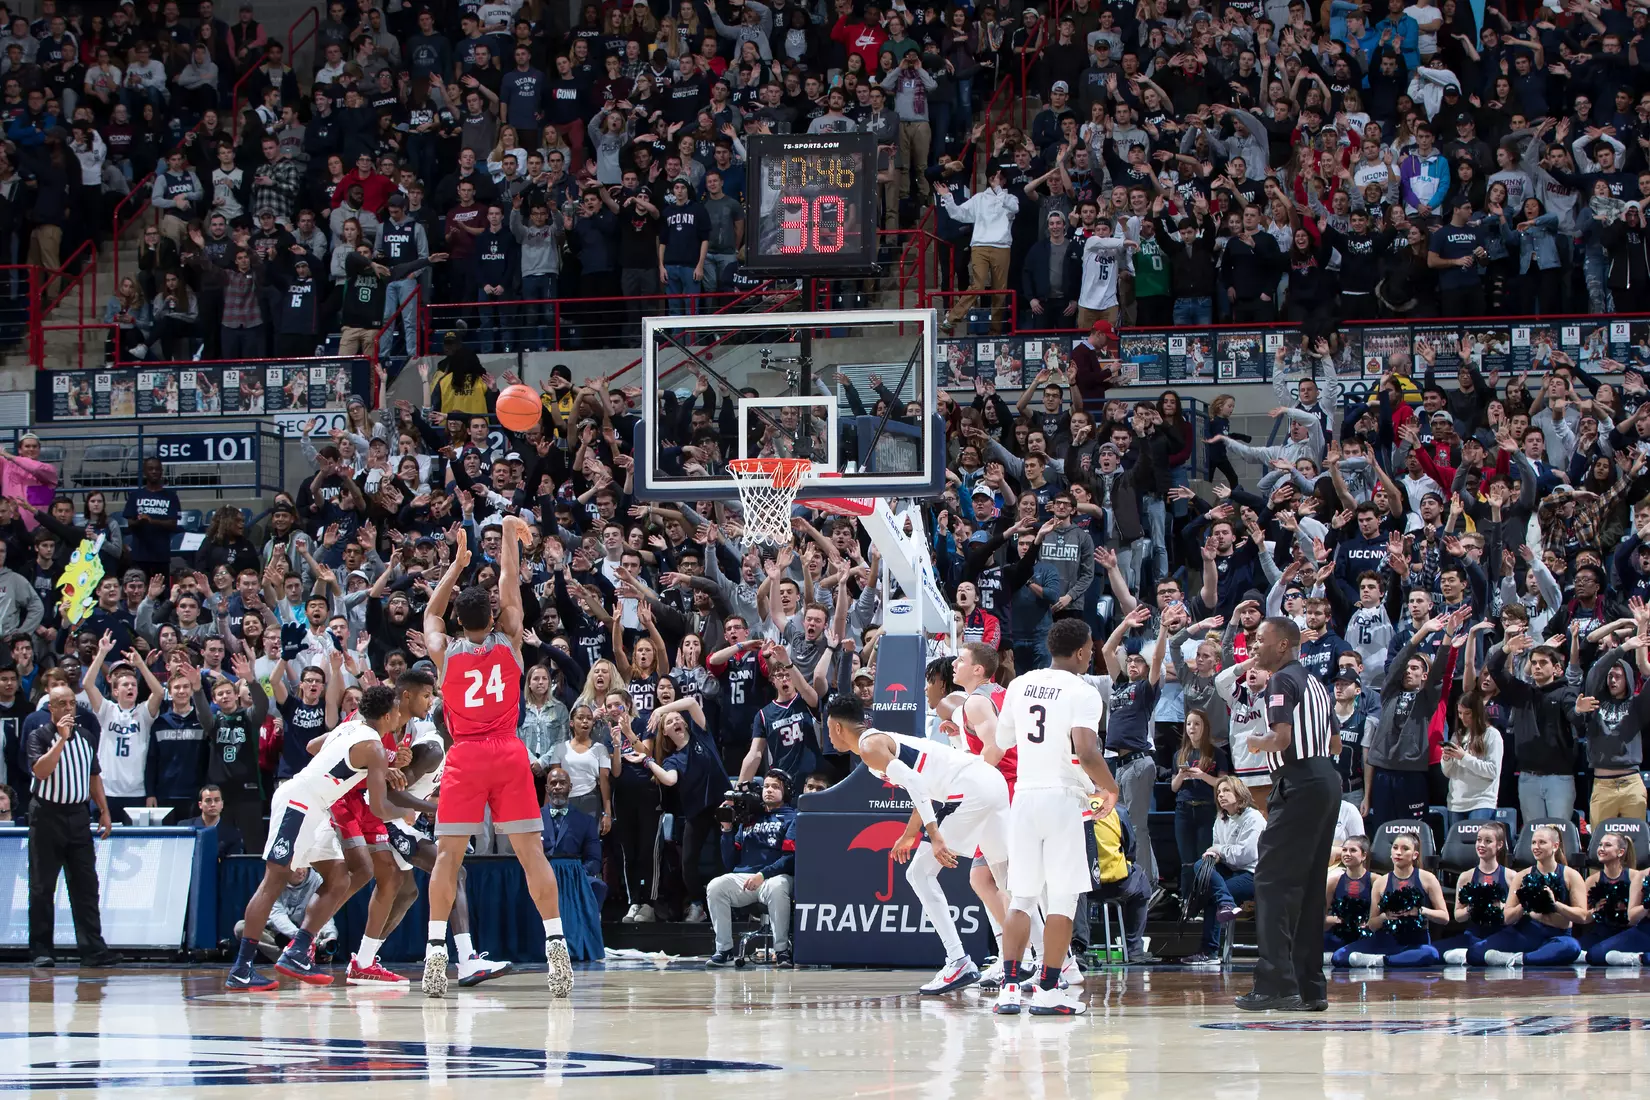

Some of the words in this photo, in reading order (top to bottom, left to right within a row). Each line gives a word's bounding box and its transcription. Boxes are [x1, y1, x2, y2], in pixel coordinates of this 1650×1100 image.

[514, 78, 536, 86] UCONN
[372, 98, 397, 107] UCONN
[781, 157, 854, 188] 17:46
[1362, 171, 1389, 184] UCONN
[169, 186, 193, 194] UCONN
[780, 196, 845, 254] 30
[384, 235, 408, 243] UCONN
[391, 243, 400, 258] 15
[1153, 258, 1163, 270] 0
[1098, 265, 1108, 280] 15
[292, 294, 302, 308] 15
[359, 288, 370, 302] 8
[1568, 328, 1575, 338] 14
[1616, 323, 1625, 334] 23
[1270, 336, 1278, 344] 31
[1518, 330, 1526, 340] 31
[1030, 342, 1036, 351] 3
[1172, 338, 1182, 347] 20
[98, 376, 108, 384] 50
[158, 444, 191, 456] SEC
[204, 438, 250, 460] 101
[136, 498, 170, 508] UCONN
[1042, 546, 1078, 558] UCONN
[982, 590, 994, 609] 15
[578, 636, 606, 646] UCONN
[1359, 626, 1372, 644] 15
[464, 664, 504, 708] 24
[730, 682, 744, 704] 15
[1024, 685, 1062, 701] GILBERT
[633, 696, 654, 711] 50
[872, 702, 918, 711] TRAVELERS
[108, 722, 140, 734] UCONN
[1028, 704, 1046, 744] 3
[164, 730, 195, 740] UCONN
[780, 726, 804, 748] 34
[116, 738, 130, 757] 15
[224, 746, 236, 762] 8
[869, 800, 916, 809] TRAVELERS
[1386, 826, 1420, 834] UCONN
[1458, 824, 1483, 834] UCO
[1530, 824, 1566, 833] UNN
[1604, 824, 1640, 833] UCONN
